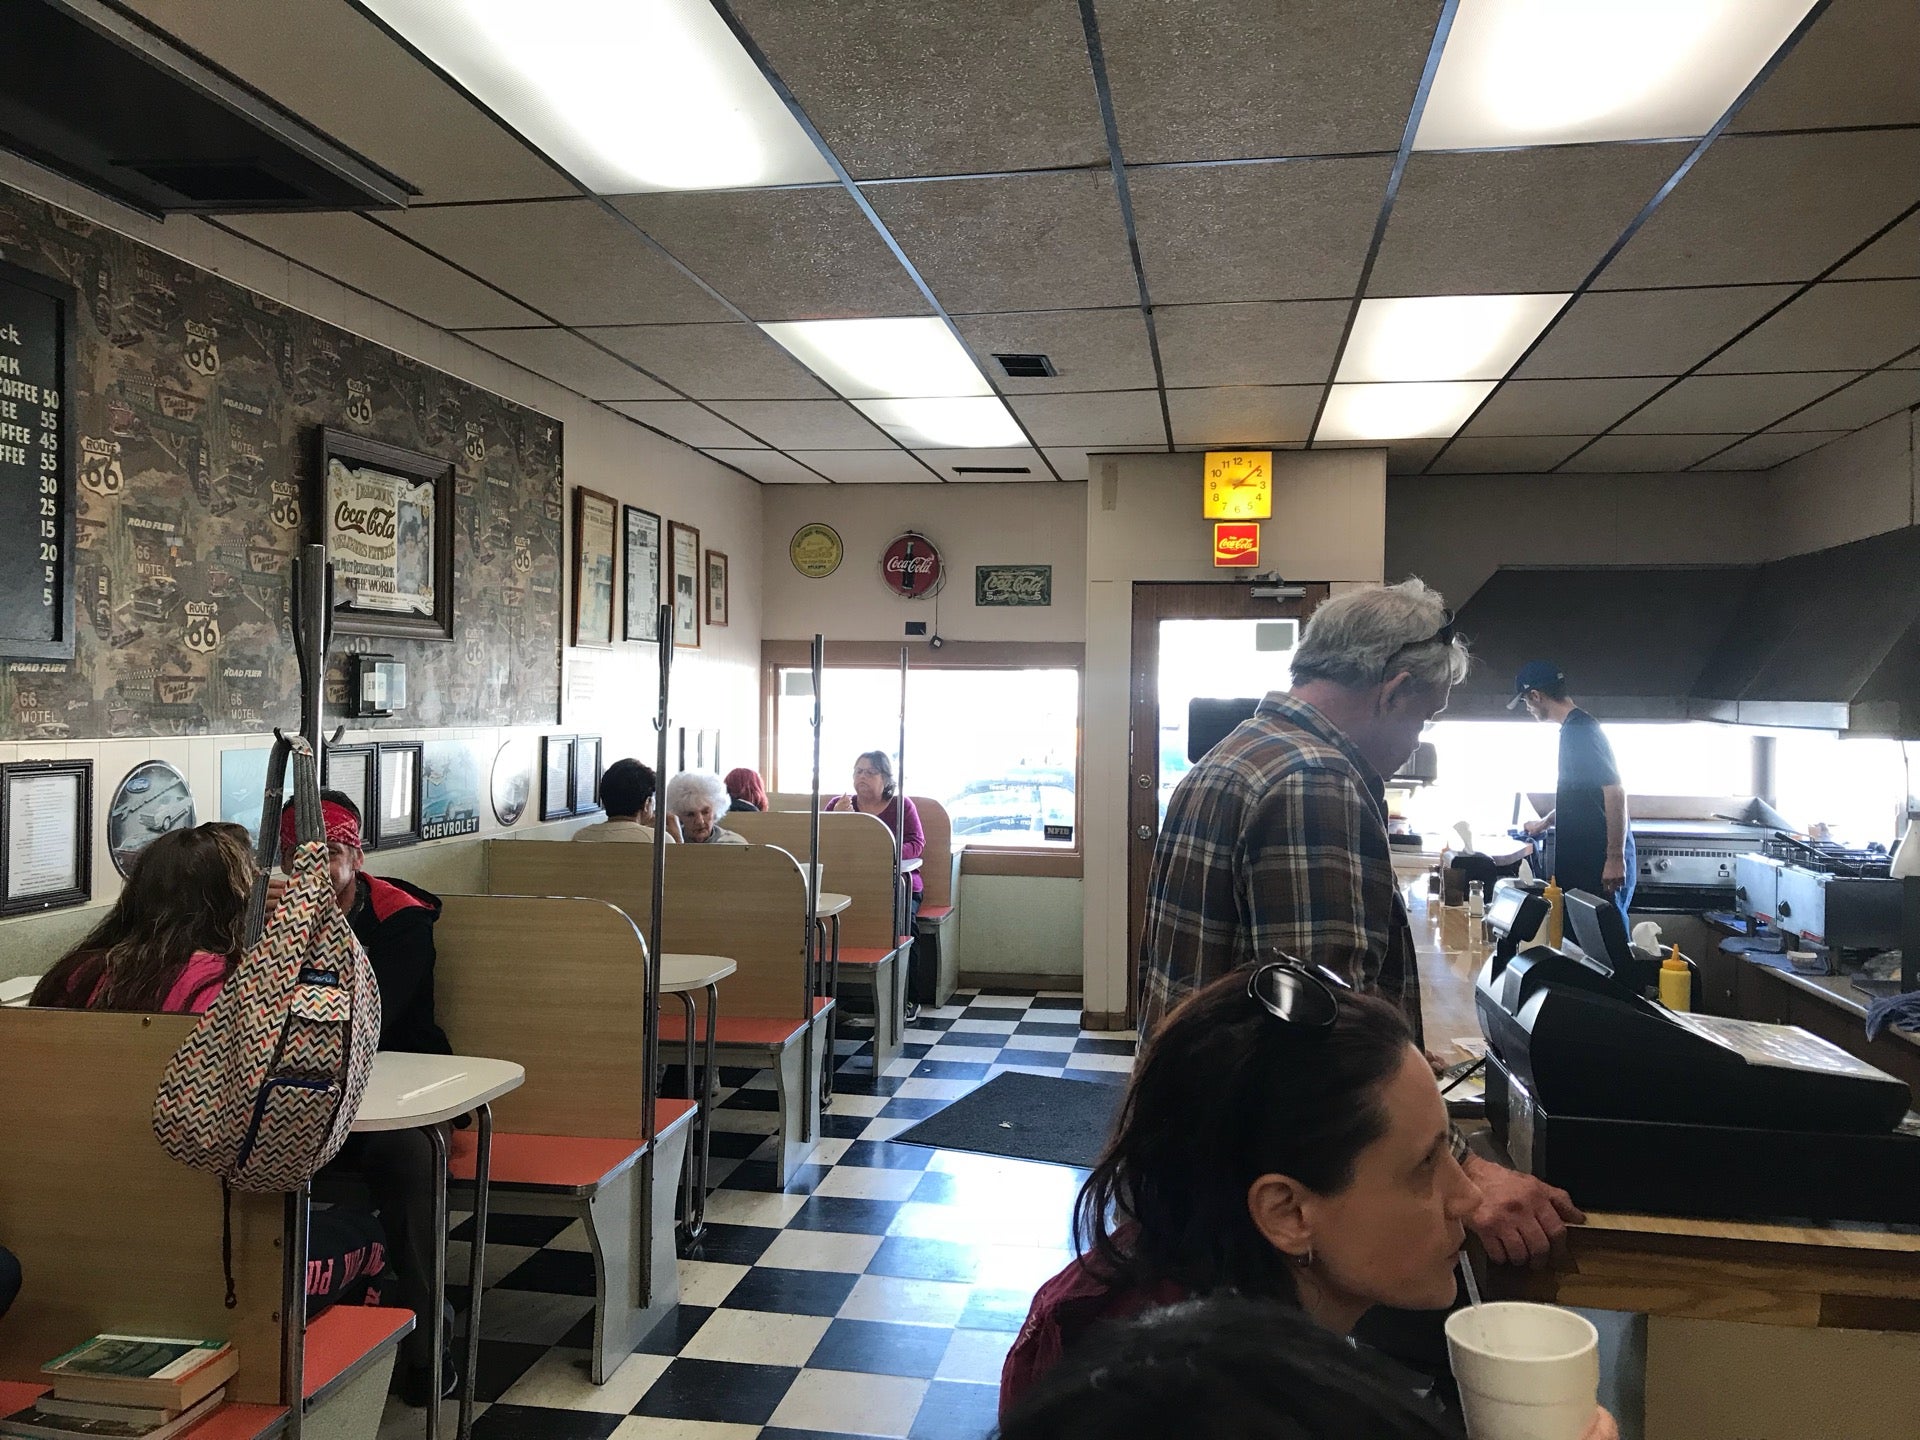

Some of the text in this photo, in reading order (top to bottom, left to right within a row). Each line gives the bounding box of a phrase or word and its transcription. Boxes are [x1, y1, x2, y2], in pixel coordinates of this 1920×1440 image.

[188, 321, 216, 338] ROUTE
[188, 337, 216, 372] 66
[0, 376, 59, 410] OFFEE 50
[40, 410, 57, 430] 55
[39, 431, 57, 451] 45
[86, 439, 118, 453] ROUTE
[231, 440, 256, 455] MOTEL
[467, 435, 484, 458] 66
[39, 452, 57, 471] 55
[1222, 460, 1230, 469] 11
[1233, 457, 1243, 466] 12
[1248, 460, 1253, 468] 1
[86, 454, 119, 490] 66
[1211, 468, 1222, 478] 10
[1256, 469, 1263, 478] 2
[39, 475, 58, 495] 30
[274, 483, 297, 495] ROUTE
[1210, 481, 1217, 490] 9
[1260, 481, 1266, 490] 3
[1213, 493, 1220, 502] 8
[1255, 493, 1262, 501] 4
[40, 497, 56, 516] 25
[274, 497, 298, 526] 66
[1222, 502, 1228, 511] 7
[1234, 505, 1241, 514] 6
[1247, 502, 1253, 510] 5
[41, 519, 56, 538] 15
[127, 517, 152, 529] ROAD
[39, 542, 58, 562] 20
[136, 545, 151, 560] 66
[516, 548, 530, 570] 66
[44, 565, 55, 583] 5
[137, 562, 168, 577] MOTEL
[368, 578, 396, 594] WORLD
[42, 588, 54, 606] 5
[189, 603, 215, 615] ROUTE
[188, 616, 217, 647] 66
[9, 662, 68, 673] ROAD FLIER
[20, 691, 38, 708] 66
[230, 693, 243, 706] 66
[20, 711, 59, 724] MOTEL
[231, 708, 257, 721] MOTEL
[423, 818, 477, 839] CHEVROLET
